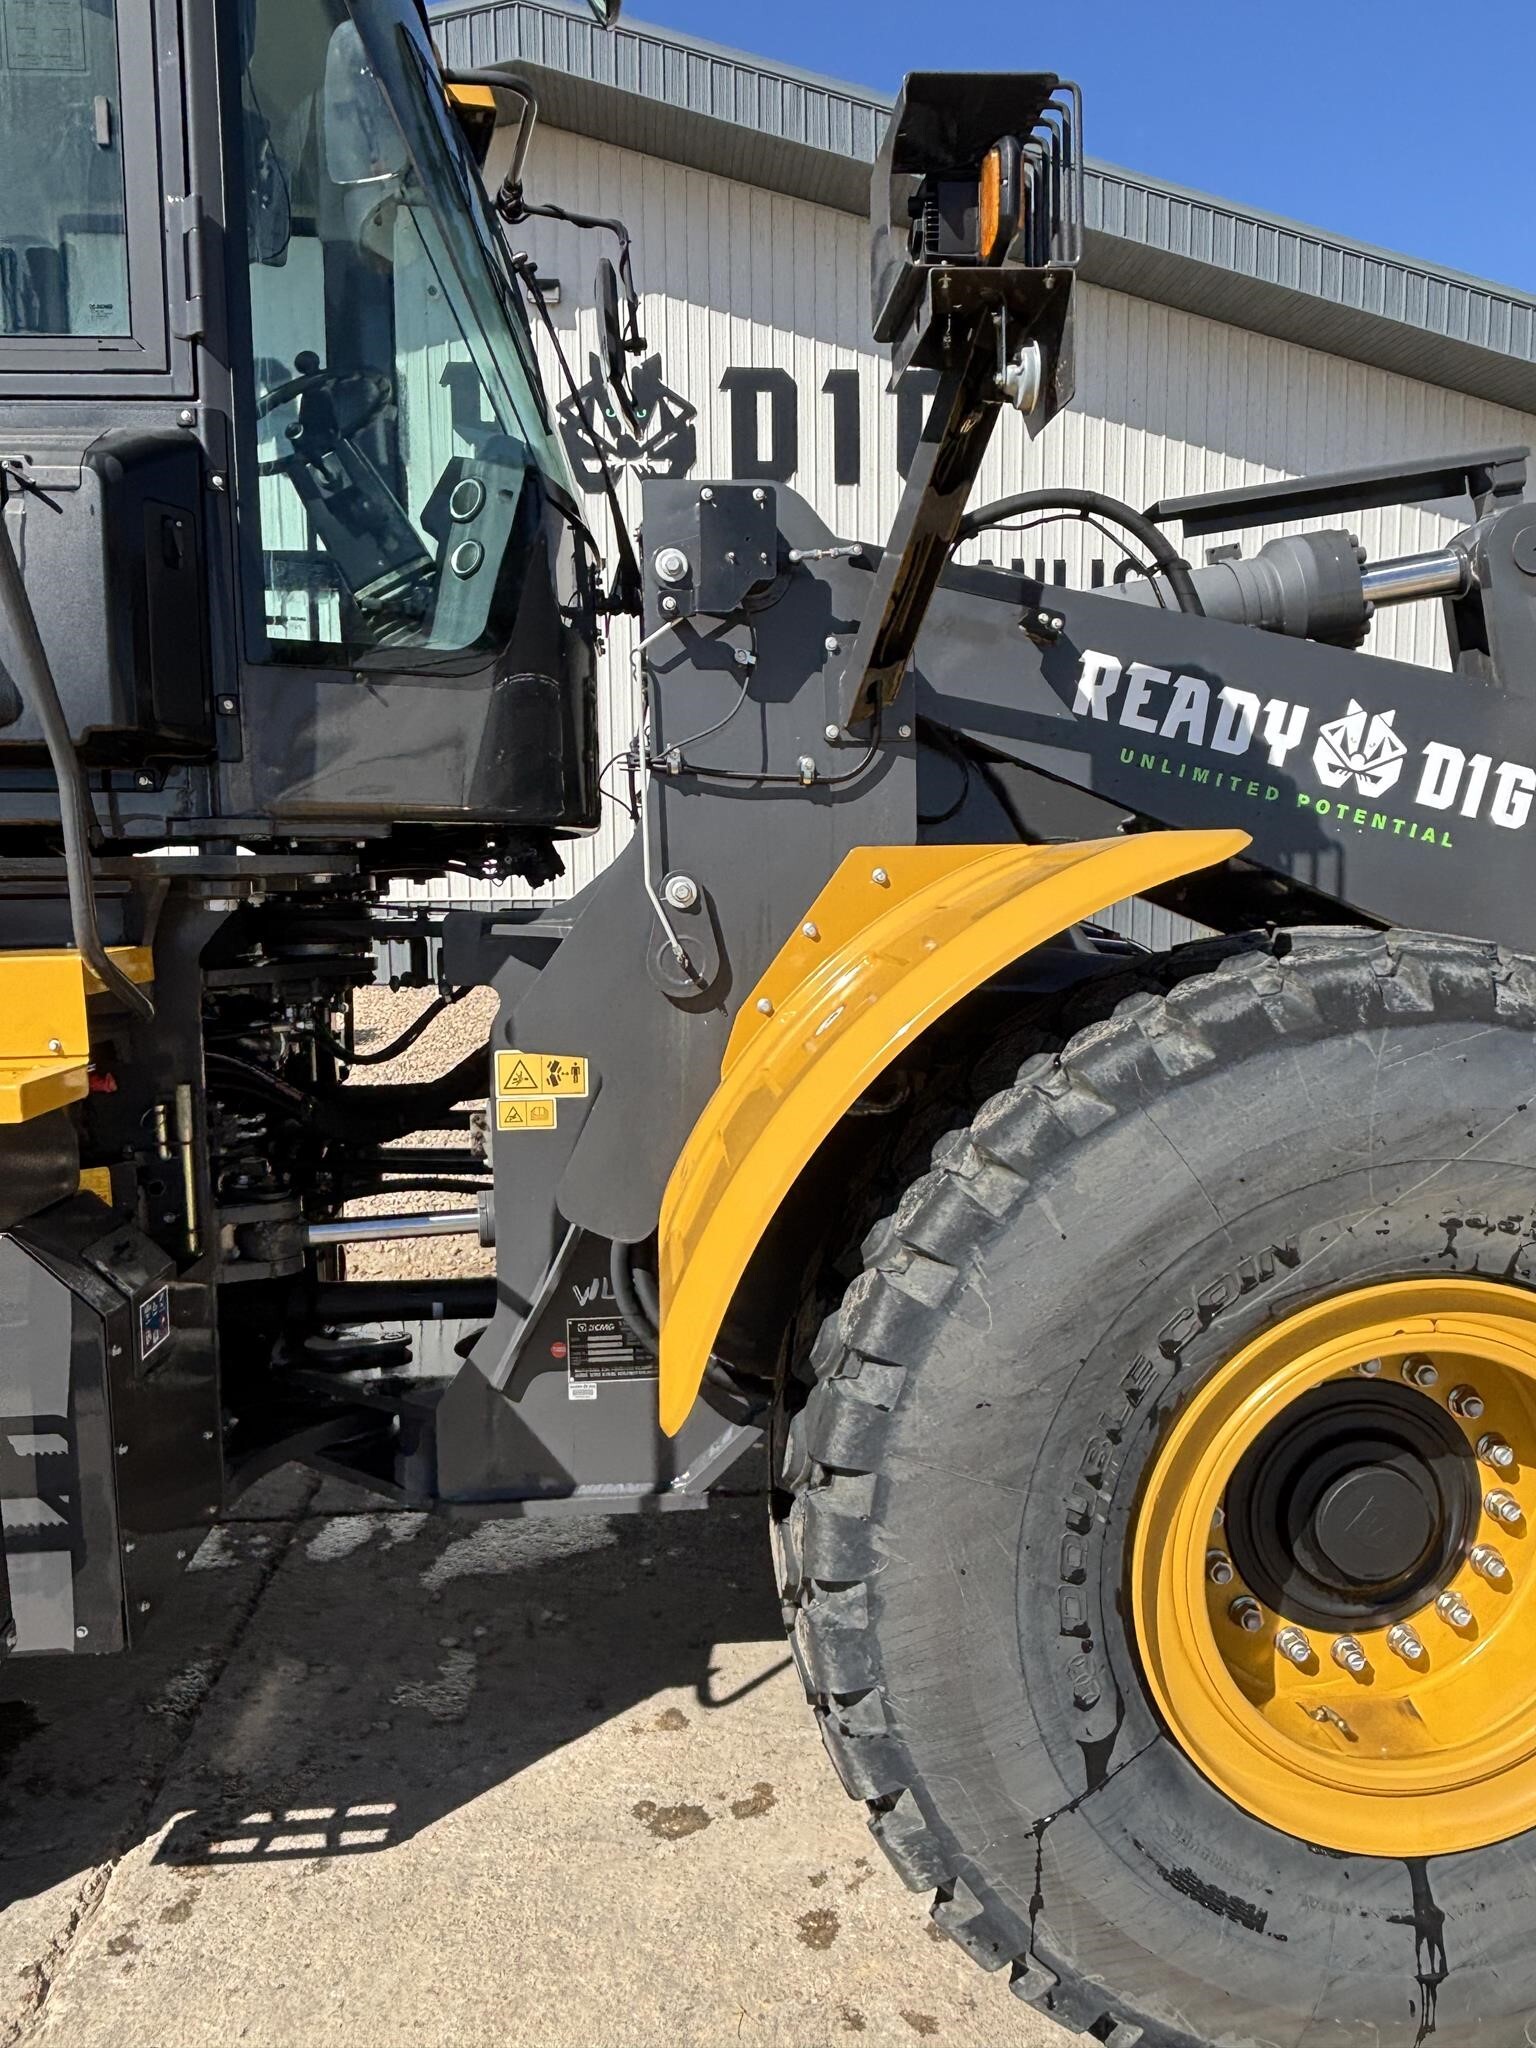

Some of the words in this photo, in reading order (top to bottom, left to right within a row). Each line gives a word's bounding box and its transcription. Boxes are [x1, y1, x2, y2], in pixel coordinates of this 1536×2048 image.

[1072, 648, 1310, 768] READY
[1120, 747, 1281, 802] UNLIMITED
[1296, 792, 1454, 849] POTENTIAL
